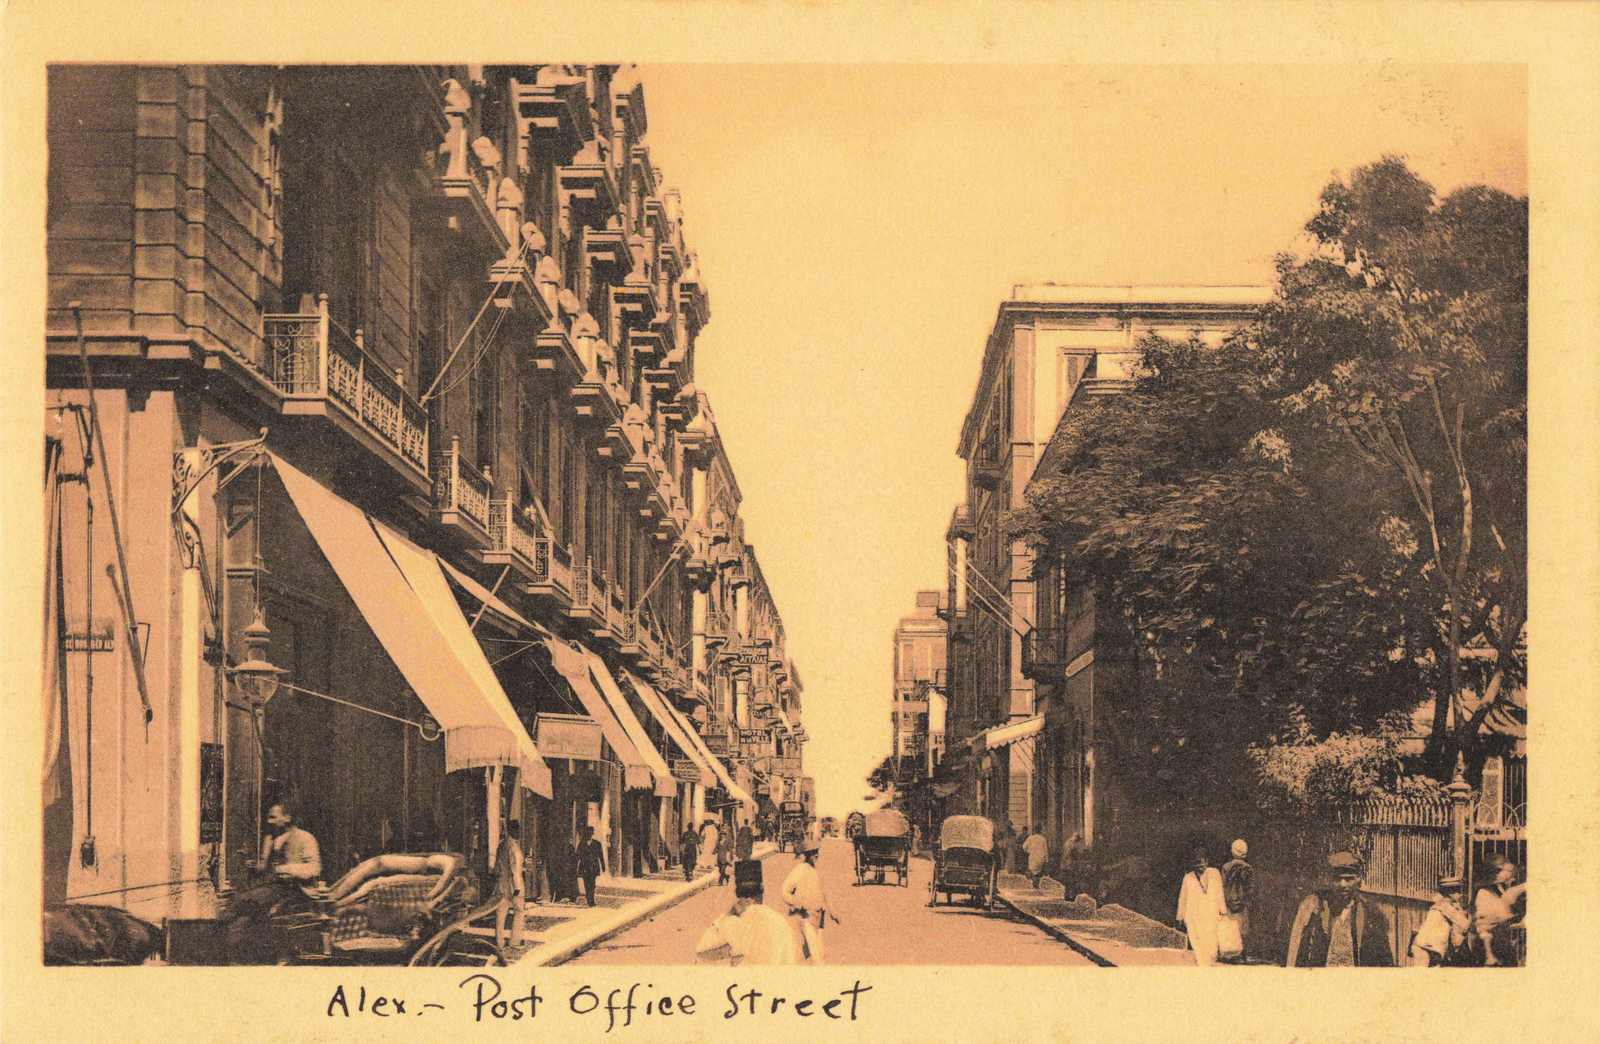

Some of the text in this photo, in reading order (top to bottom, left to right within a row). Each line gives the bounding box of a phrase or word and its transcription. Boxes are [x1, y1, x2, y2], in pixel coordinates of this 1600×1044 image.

[459, 975, 543, 1022] Post
[569, 983, 696, 1033] Office
[724, 980, 873, 1021] Street
